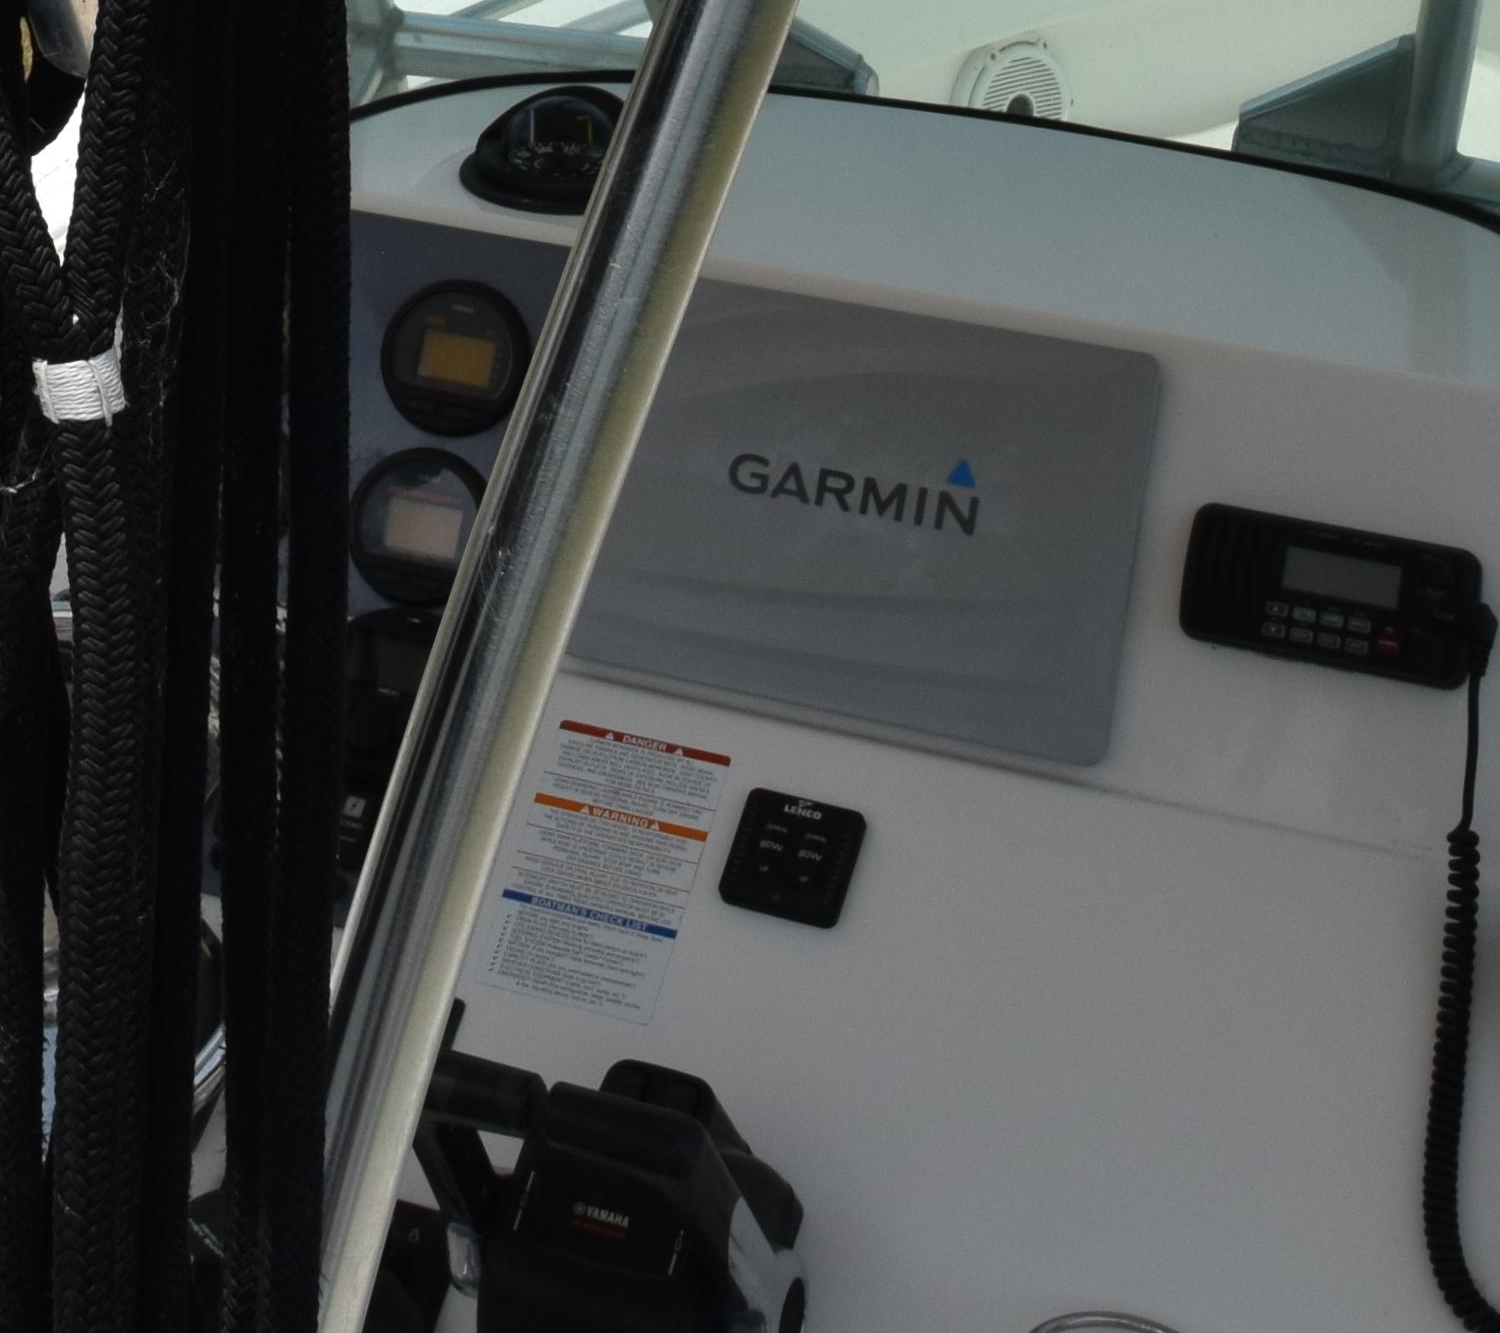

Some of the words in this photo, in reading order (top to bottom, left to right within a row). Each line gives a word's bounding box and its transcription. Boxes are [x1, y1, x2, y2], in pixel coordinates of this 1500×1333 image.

[728, 453, 980, 536] GARMIN
[622, 735, 668, 753] DANGER
[591, 807, 649, 829] WARNING
[783, 803, 822, 821] LENCO
[531, 896, 588, 918] BOATMAN'S
[589, 909, 626, 926] CHECK
[626, 919, 648, 931] LIST
[587, 1205, 630, 1228] YAMAHA
